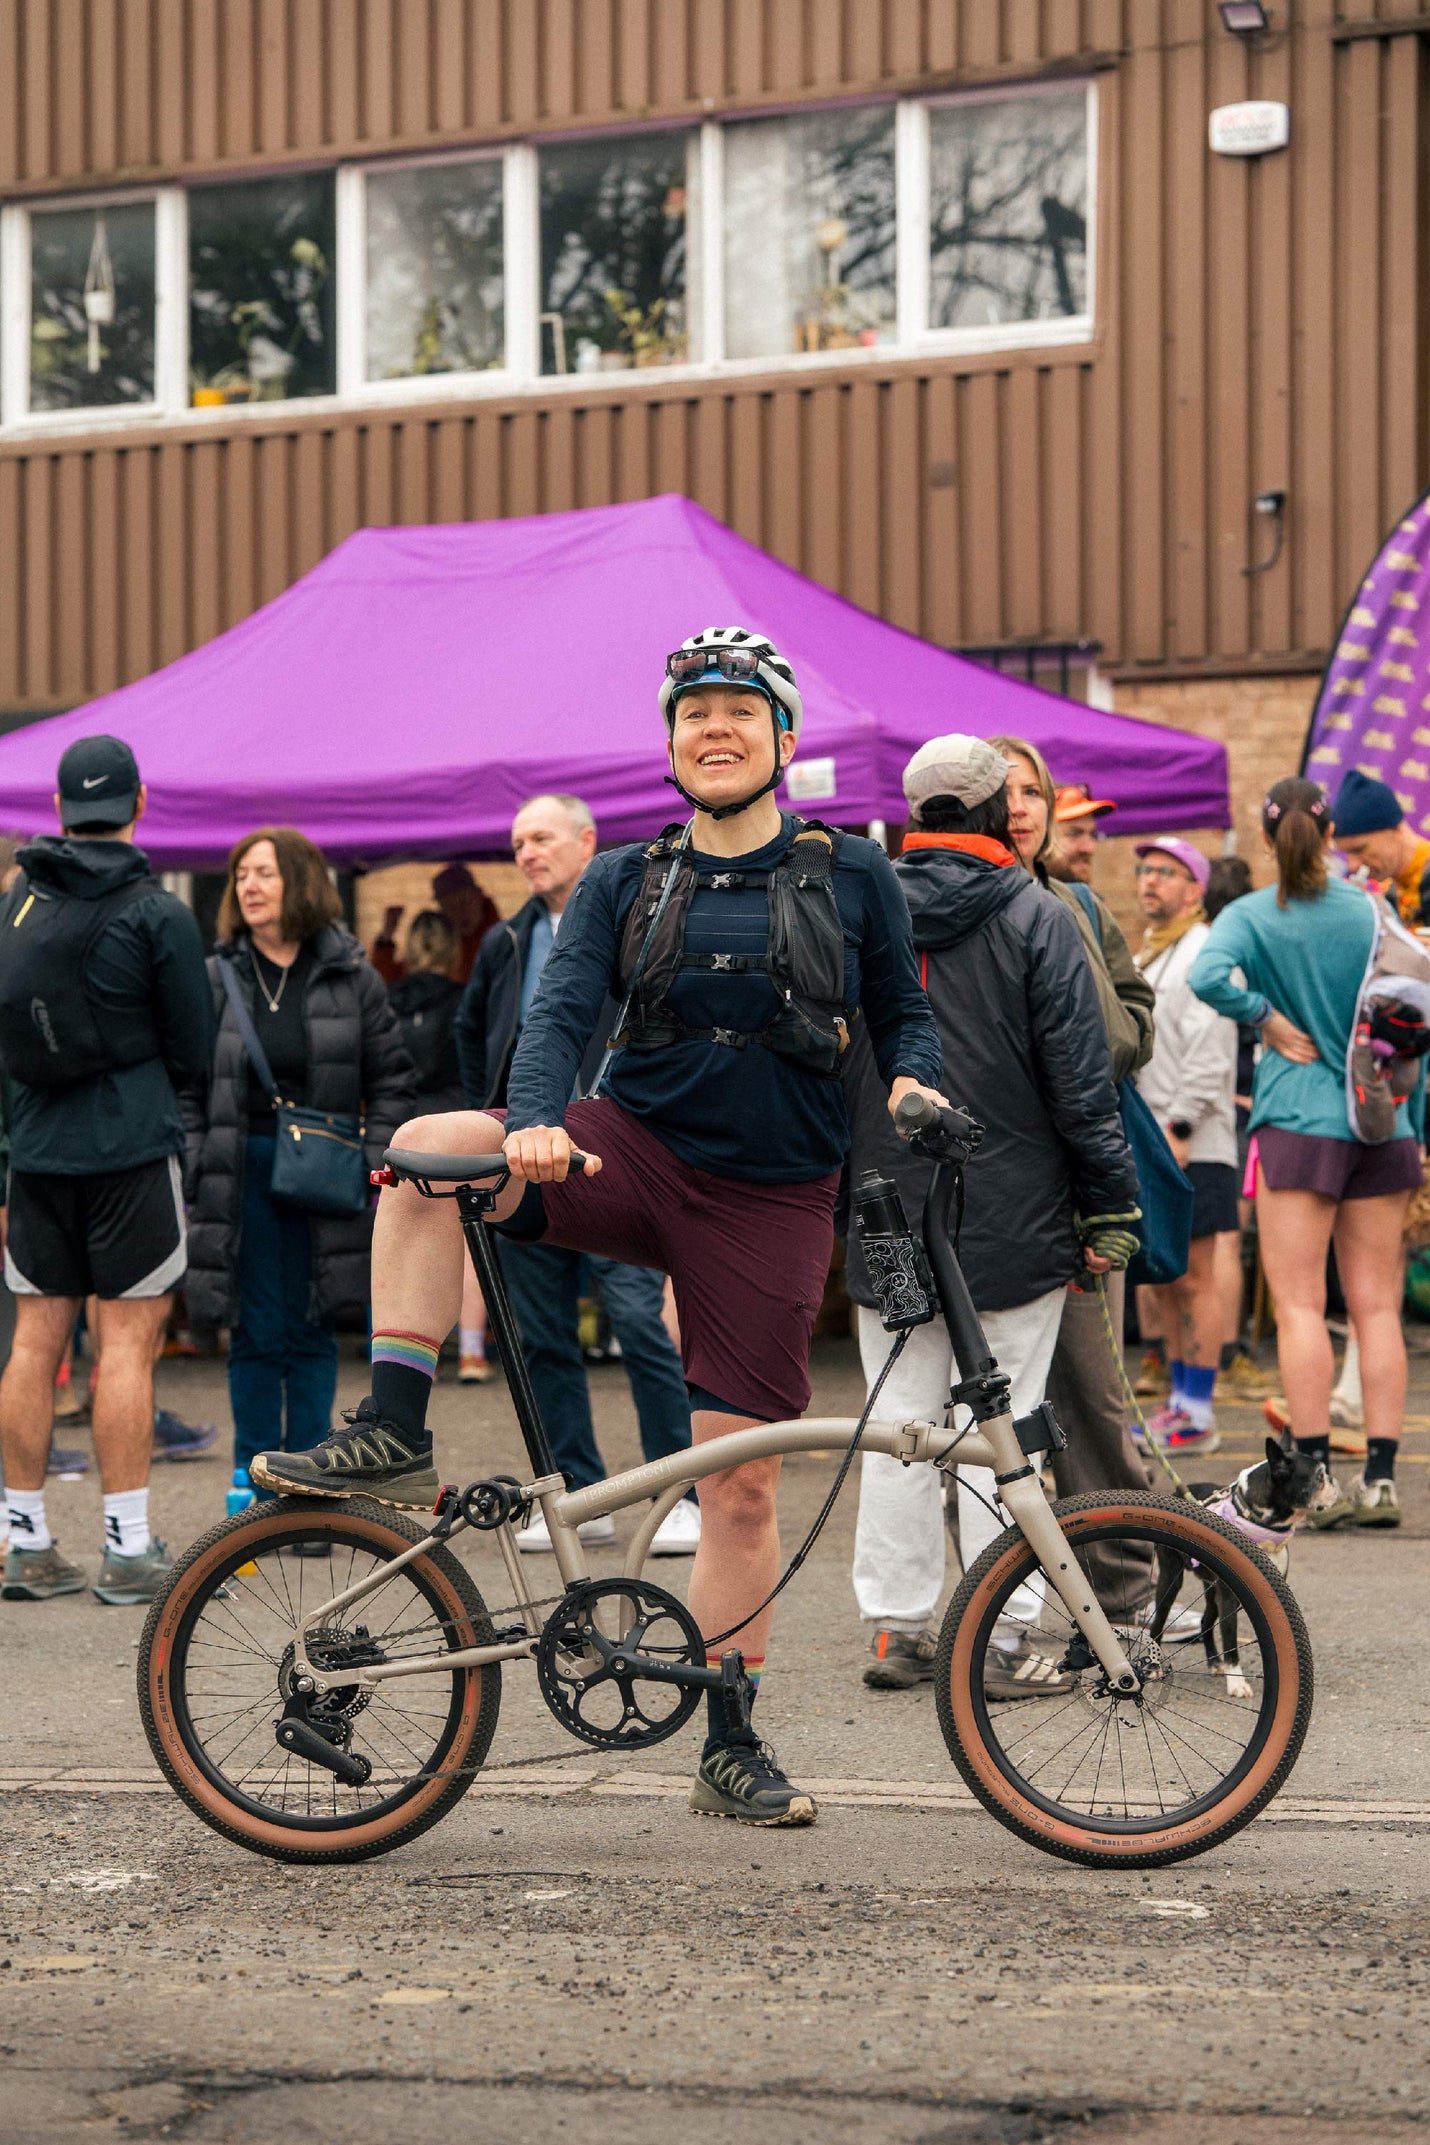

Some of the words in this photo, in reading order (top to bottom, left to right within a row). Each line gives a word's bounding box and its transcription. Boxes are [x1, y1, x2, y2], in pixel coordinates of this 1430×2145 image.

[590, 1463, 664, 1500] BROMPTON
[1122, 1512, 1176, 1527] G-ONE
[164, 1590, 191, 1638] G-ONE
[422, 1567, 468, 1647] SCHWABE
[159, 1702, 200, 1785] SCHWALBE
[449, 1715, 470, 1764] G-ONE
[1010, 1797, 1055, 1831] G-ONE
[1121, 1817, 1212, 1847] SCHWALBE
